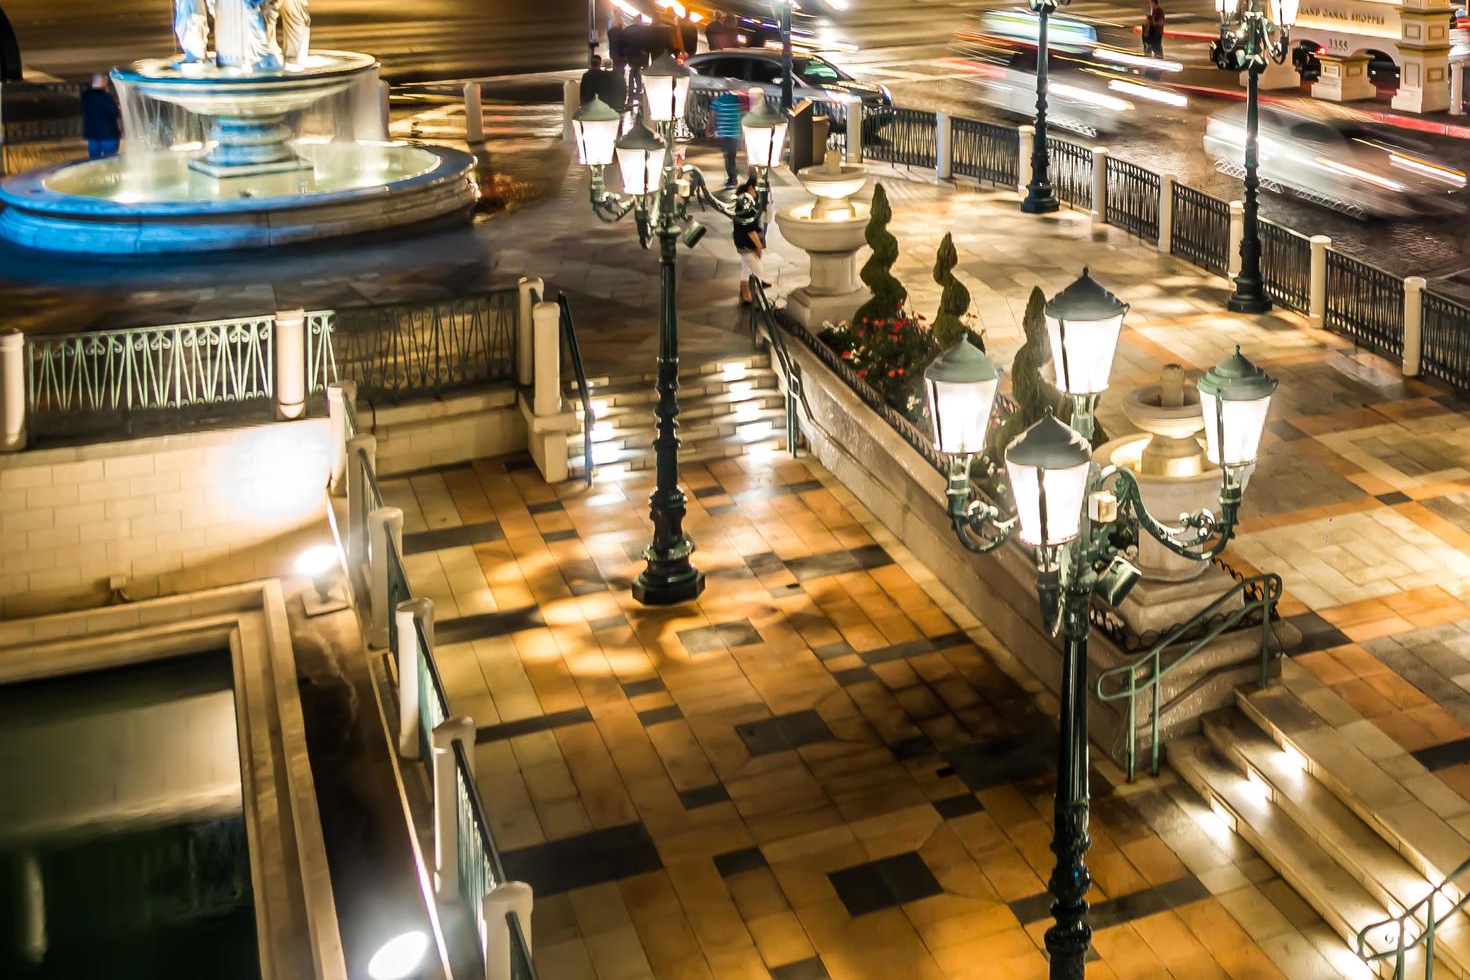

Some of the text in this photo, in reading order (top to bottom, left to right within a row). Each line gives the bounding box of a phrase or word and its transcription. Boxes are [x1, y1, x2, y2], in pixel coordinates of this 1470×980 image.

[1299, 6, 1385, 25] RAND CANAL SHOPPES
[1328, 38, 1349, 52] 3355
